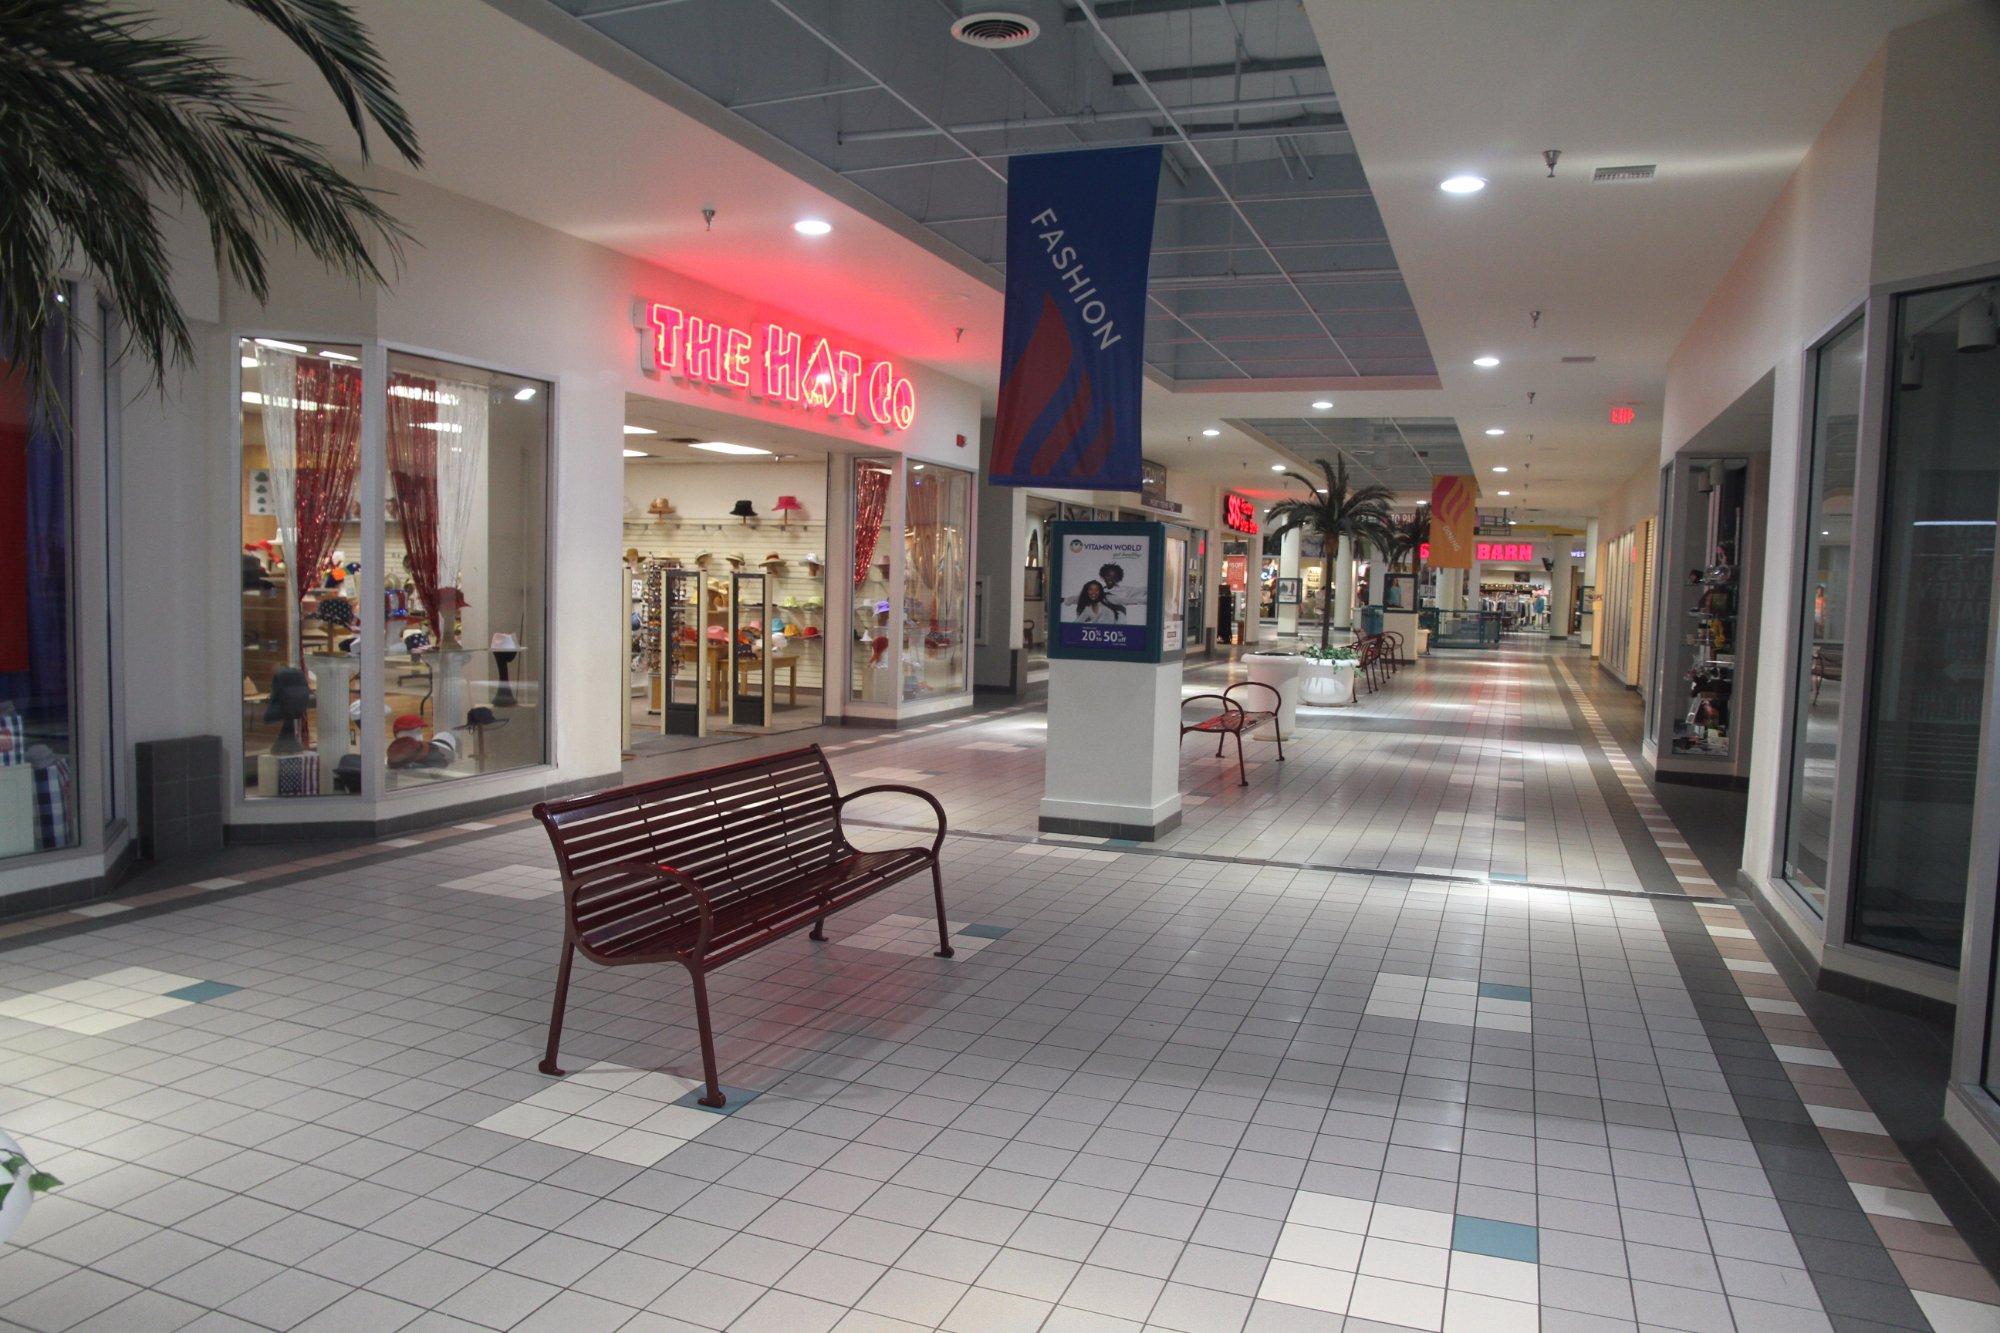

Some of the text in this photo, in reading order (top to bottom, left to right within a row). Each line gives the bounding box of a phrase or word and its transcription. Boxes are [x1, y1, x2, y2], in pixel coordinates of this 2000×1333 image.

[1030, 207, 1122, 351] FASHION
[650, 302, 752, 387] THE
[764, 323, 863, 416] HAT
[1114, 544, 1141, 552] WORLD
[1442, 525, 1462, 552] DINING
[1477, 543, 1534, 562] BARN
